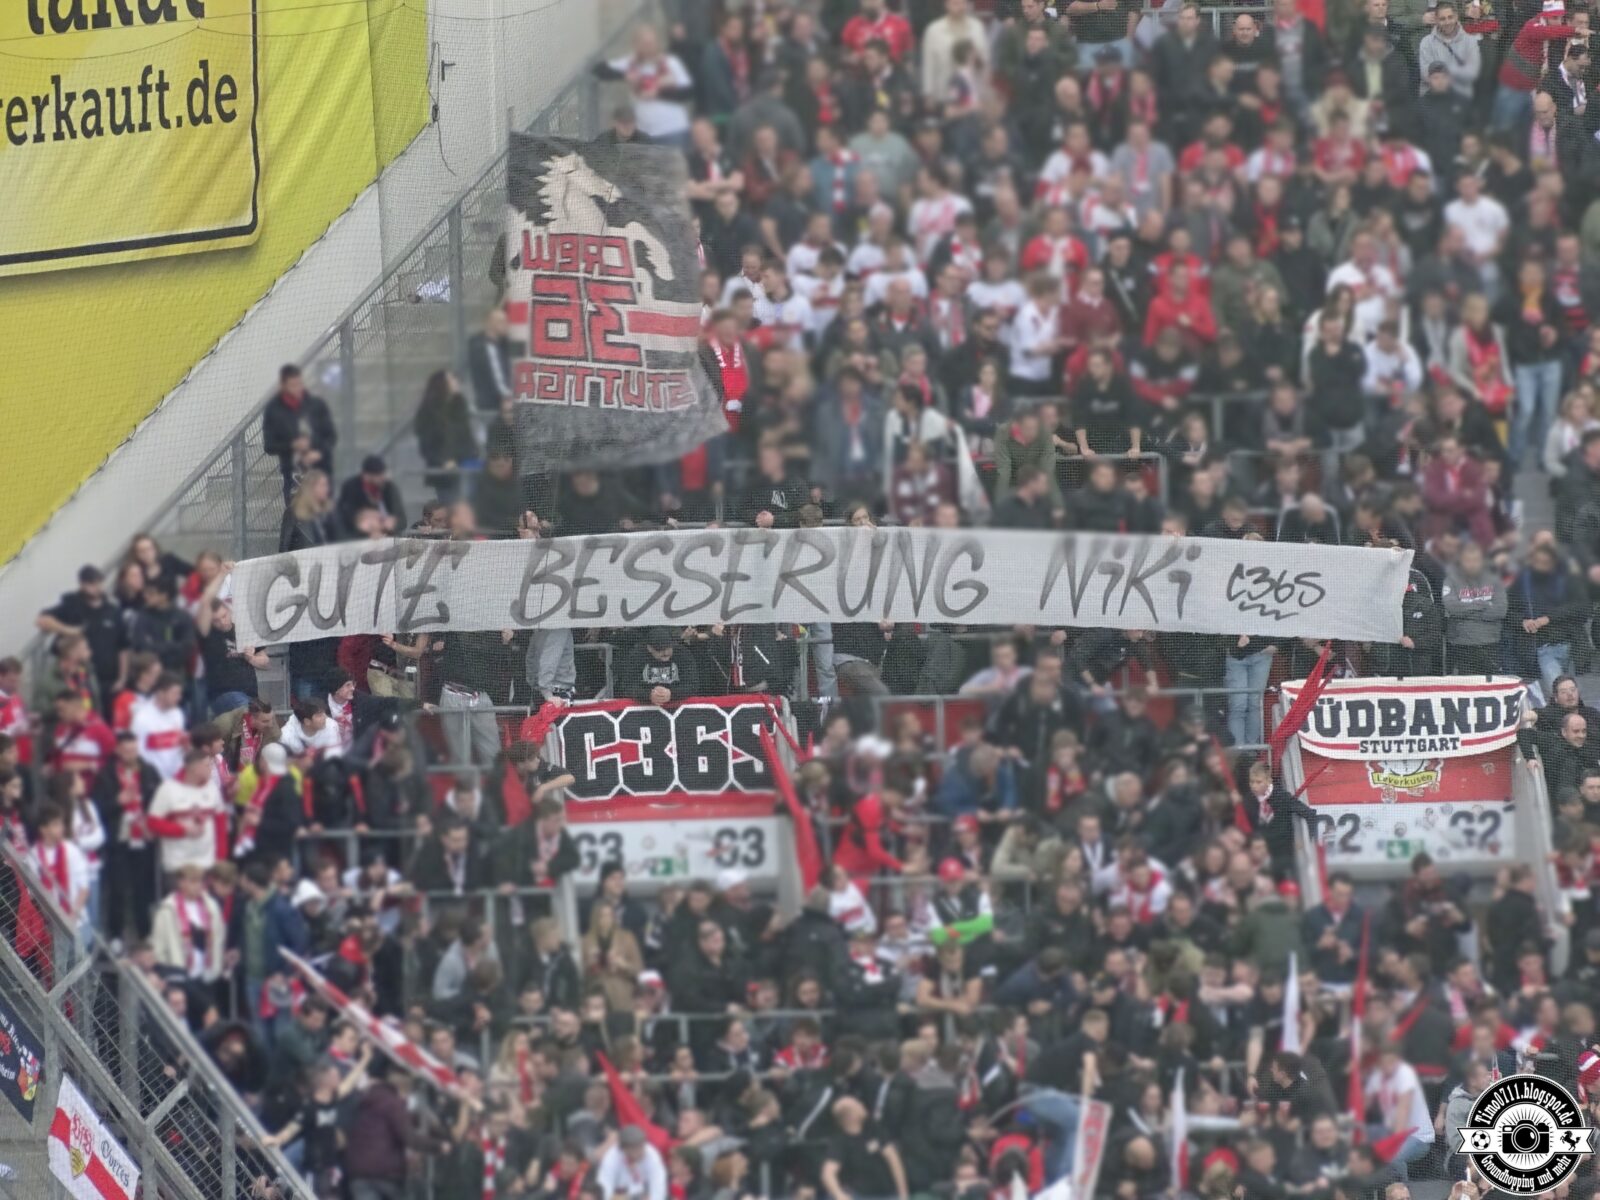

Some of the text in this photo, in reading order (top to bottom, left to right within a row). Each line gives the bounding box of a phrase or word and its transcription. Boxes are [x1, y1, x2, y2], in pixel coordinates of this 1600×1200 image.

[0, 59, 238, 146] erkauft.de
[246, 541, 470, 641] GUTE
[510, 527, 989, 621] BESSERUNG
[1360, 737, 1460, 754] STUTTGART
